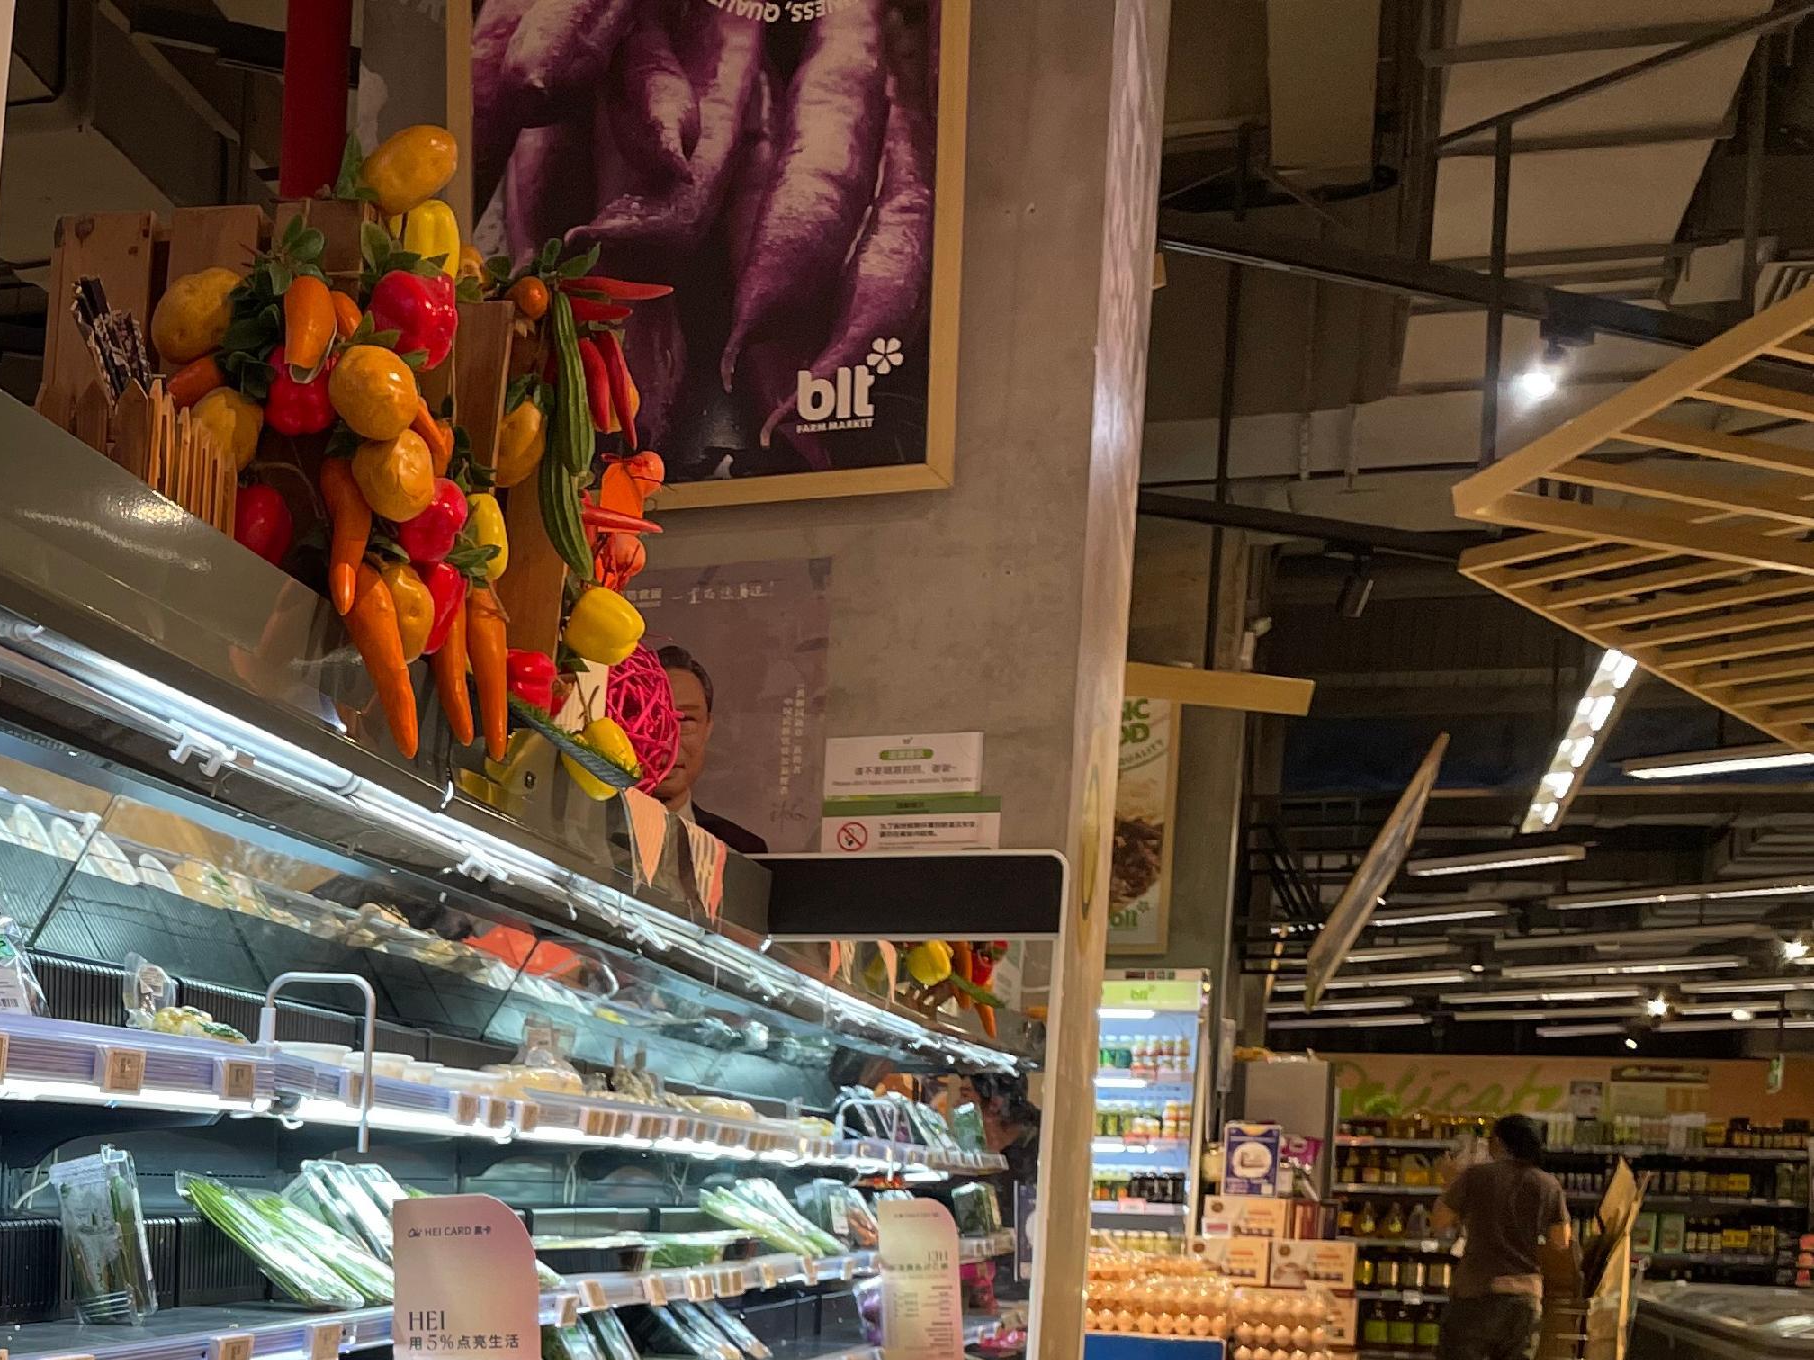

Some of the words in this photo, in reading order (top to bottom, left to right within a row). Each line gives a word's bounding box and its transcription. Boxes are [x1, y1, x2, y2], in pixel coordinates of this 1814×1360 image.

[797, 364, 875, 421] blt
[796, 422, 826, 434] FARM
[828, 418, 874, 430] MARKET
[425, 1228, 442, 1236] HEI
[444, 1226, 471, 1236] CARD
[409, 1310, 445, 1331] HEI
